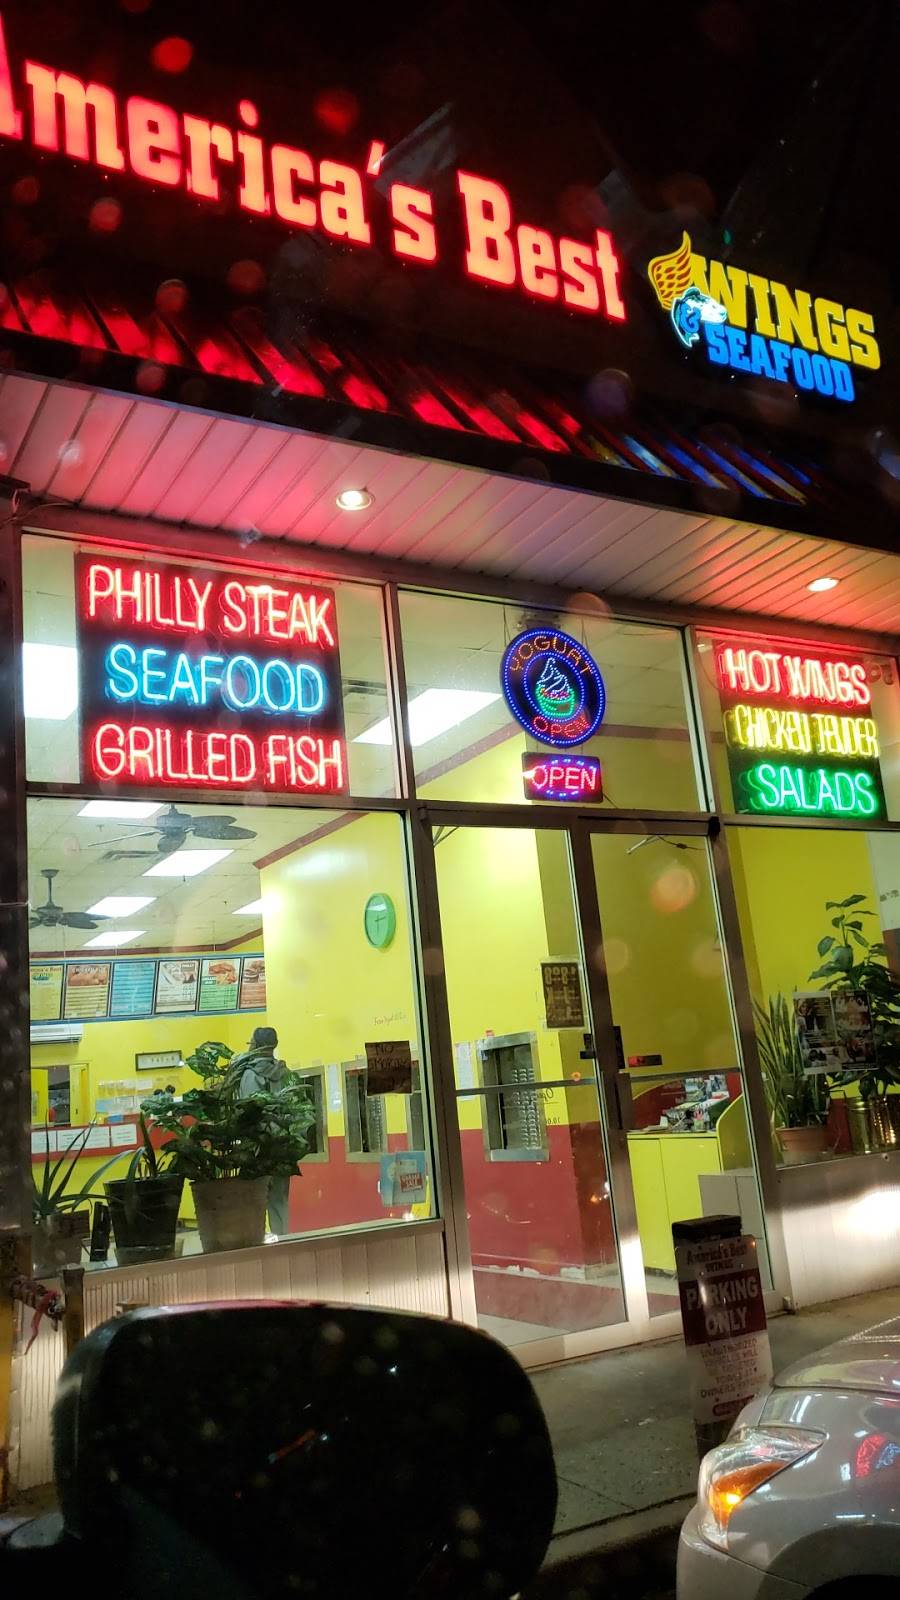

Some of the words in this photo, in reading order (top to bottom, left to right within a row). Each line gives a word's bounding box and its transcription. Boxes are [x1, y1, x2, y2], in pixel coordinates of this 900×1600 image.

[457, 168, 626, 322] Best
[690, 252, 880, 370] WINGS
[703, 321, 856, 402] SEAFOOD
[88, 564, 213, 631] PHILLY
[222, 581, 335, 647] STEAK
[109, 643, 324, 713] SEAFOOD
[509, 635, 594, 674] YOGURT
[724, 648, 782, 693] HOT
[784, 655, 871, 705] WINGS
[94, 723, 257, 782] GRILLED
[268, 734, 343, 789] FISH
[533, 714, 590, 738] OPEN
[532, 764, 597, 790] OPEN
[757, 763, 875, 814] SALADS
[705, 1306, 749, 1336] ONLY
